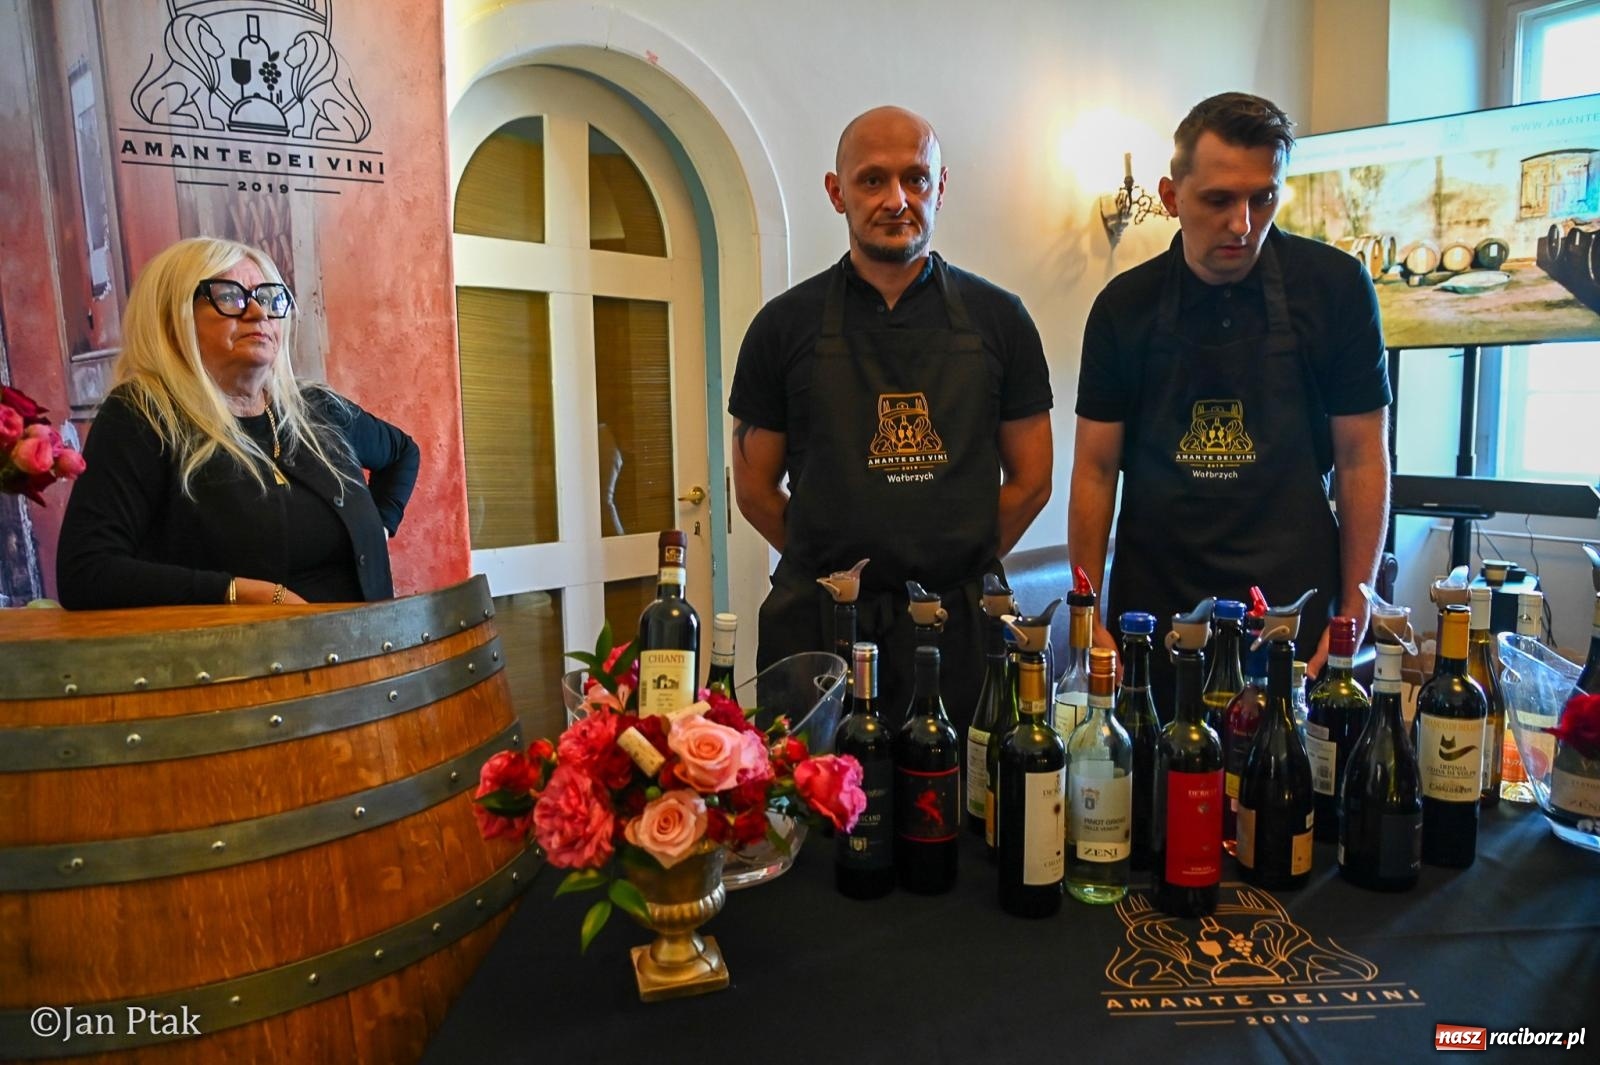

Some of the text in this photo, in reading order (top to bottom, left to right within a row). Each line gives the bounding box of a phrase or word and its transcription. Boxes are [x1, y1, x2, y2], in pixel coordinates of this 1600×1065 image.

[121, 139, 385, 175] AMANTE DEI VINI
[237, 181, 290, 195] 2019
[868, 456, 907, 465] AMANTE
[909, 455, 926, 463] DEI
[887, 472, 934, 483] Wałbrzych
[1192, 470, 1238, 480] Wałbrzych
[648, 653, 686, 665] CHIANTI
[1084, 817, 1105, 826] PINOT
[1084, 847, 1118, 858] ZENI
[1106, 988, 1421, 1009] AMANTE DEI VINI
